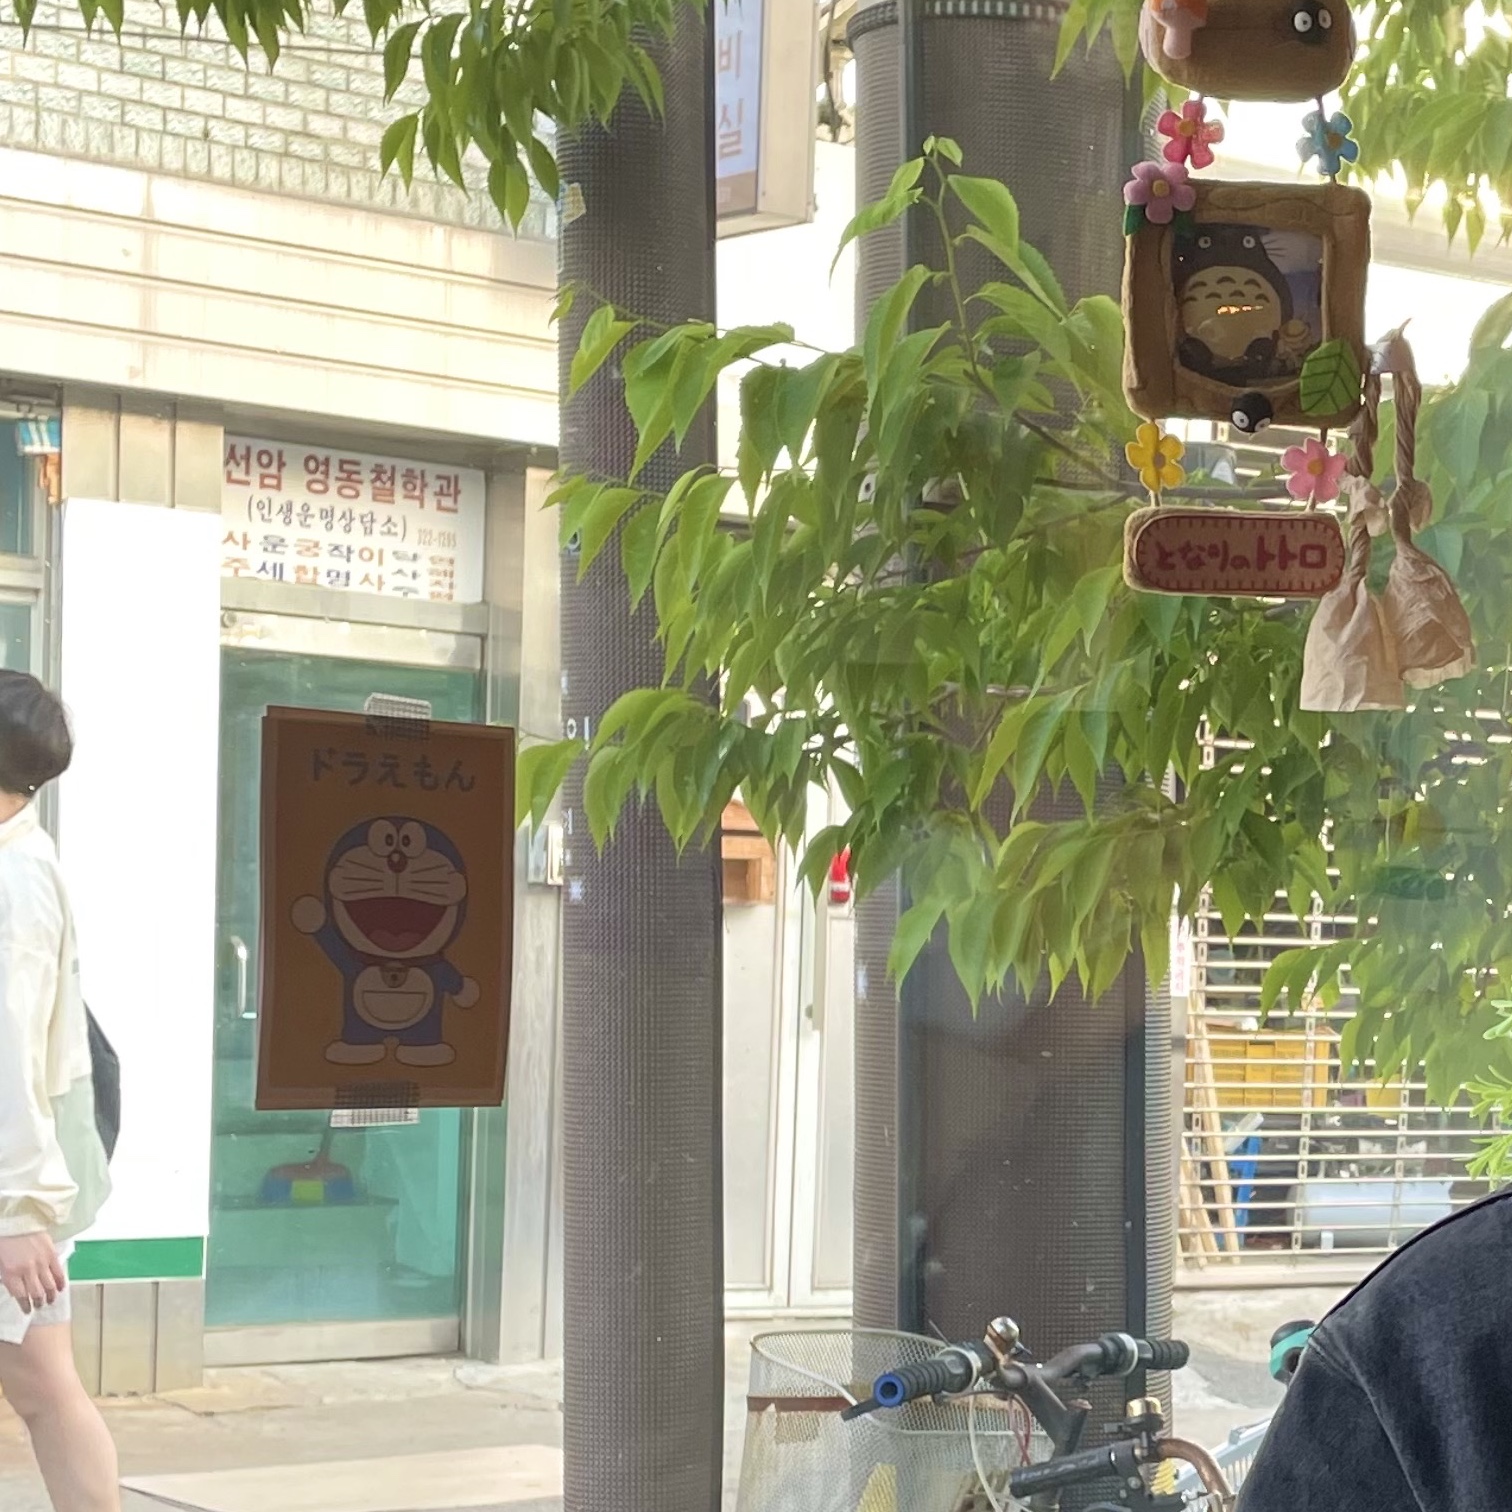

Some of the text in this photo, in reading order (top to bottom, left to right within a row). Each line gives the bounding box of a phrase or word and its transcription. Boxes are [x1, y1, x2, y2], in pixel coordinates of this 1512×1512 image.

[224, 443, 462, 515] 선암 영동철학관
[312, 747, 477, 793] ドラえもん
